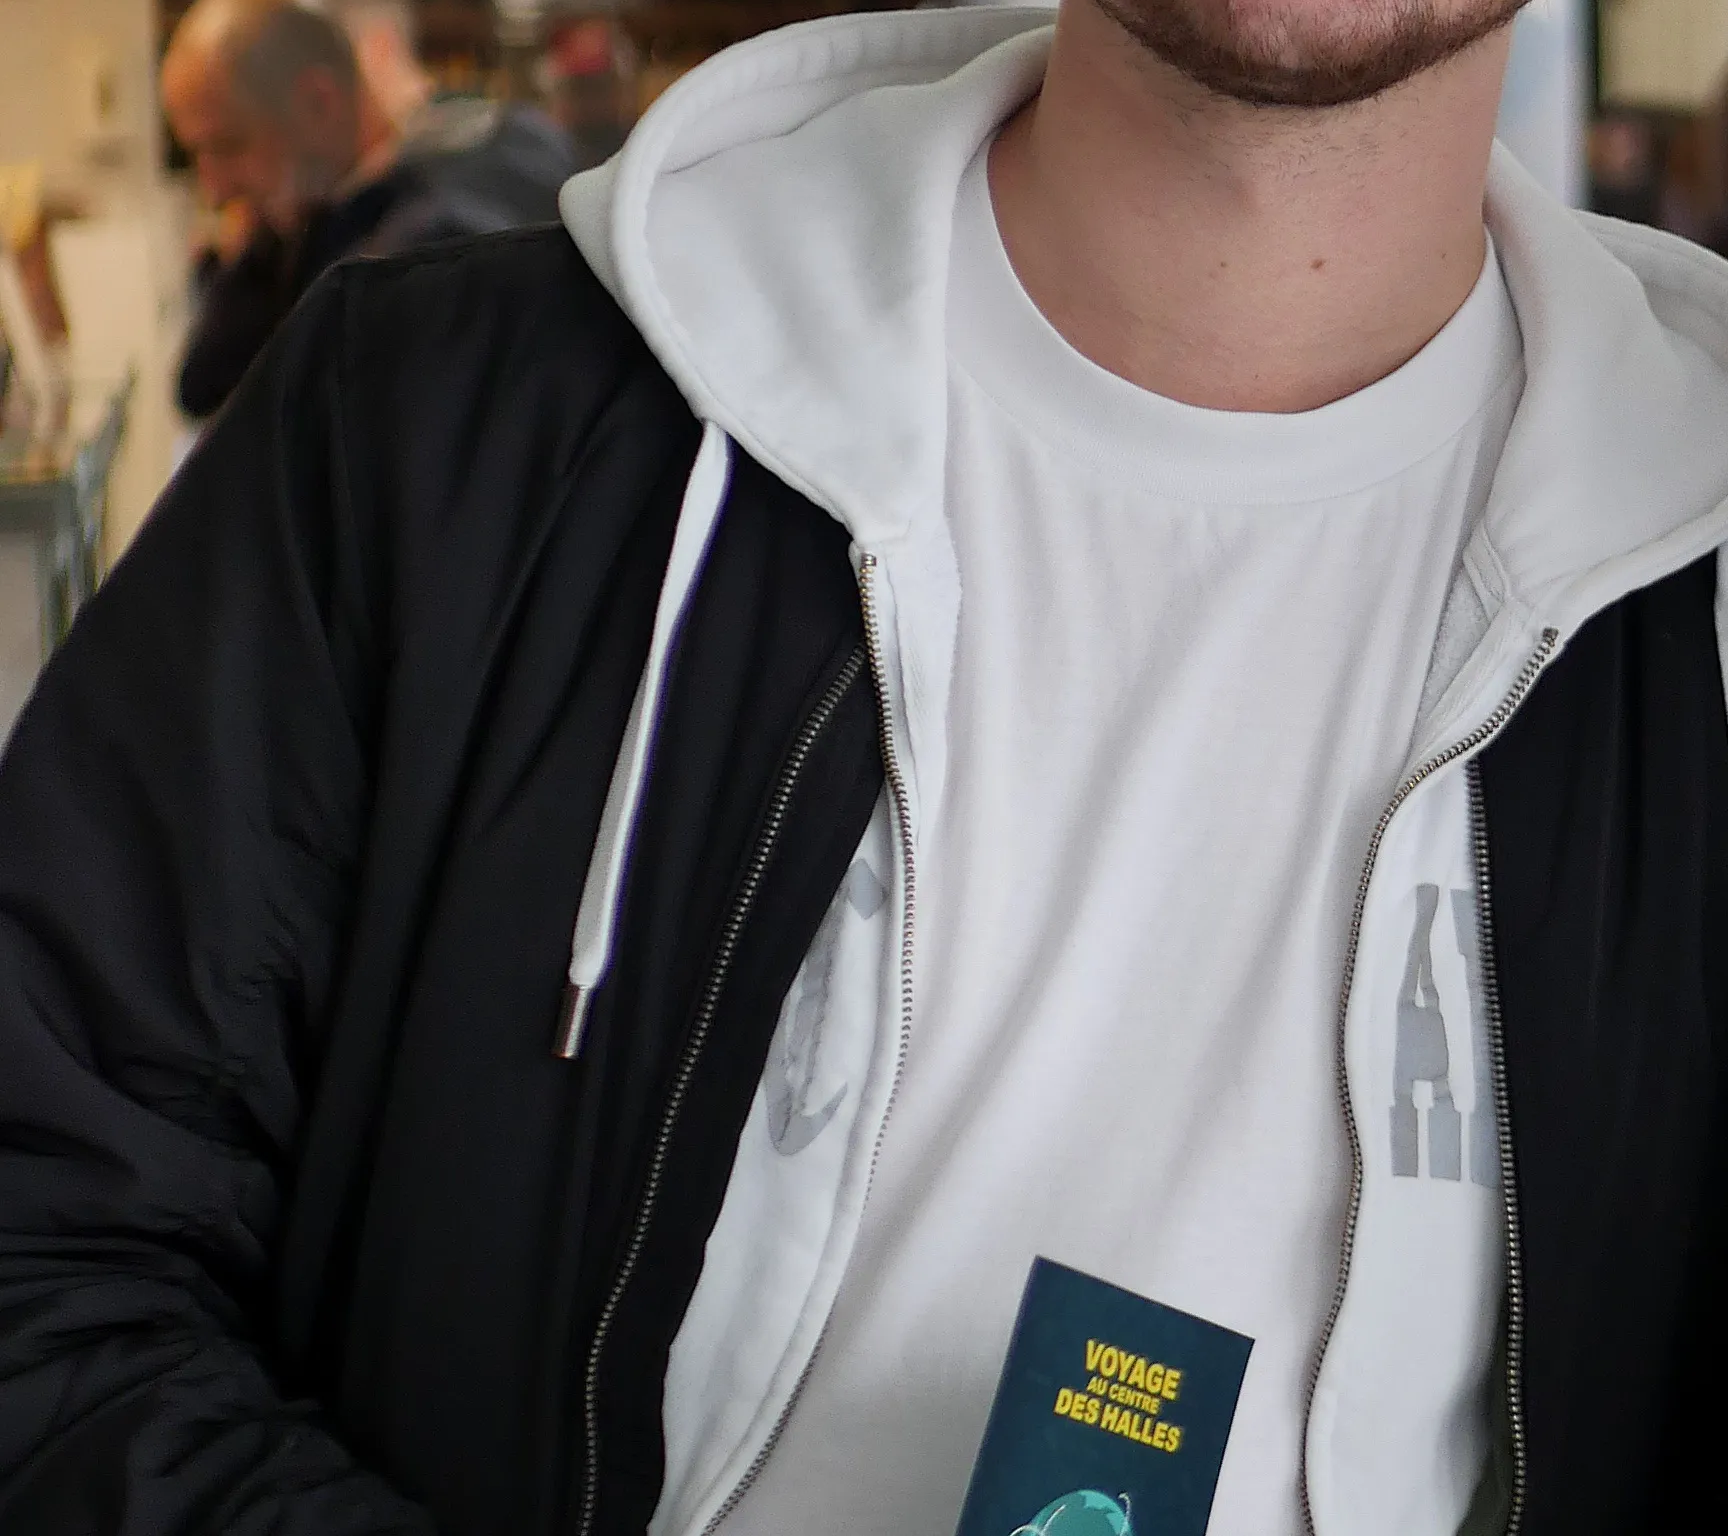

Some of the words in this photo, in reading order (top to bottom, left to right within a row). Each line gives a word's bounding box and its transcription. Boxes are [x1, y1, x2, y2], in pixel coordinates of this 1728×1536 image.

[1085, 1339, 1181, 1401] VOYAGE
[1086, 1376, 1109, 1396] AU
[1108, 1383, 1161, 1415] CENTRE
[1053, 1387, 1101, 1425] DES
[1100, 1404, 1181, 1453] HALLES
